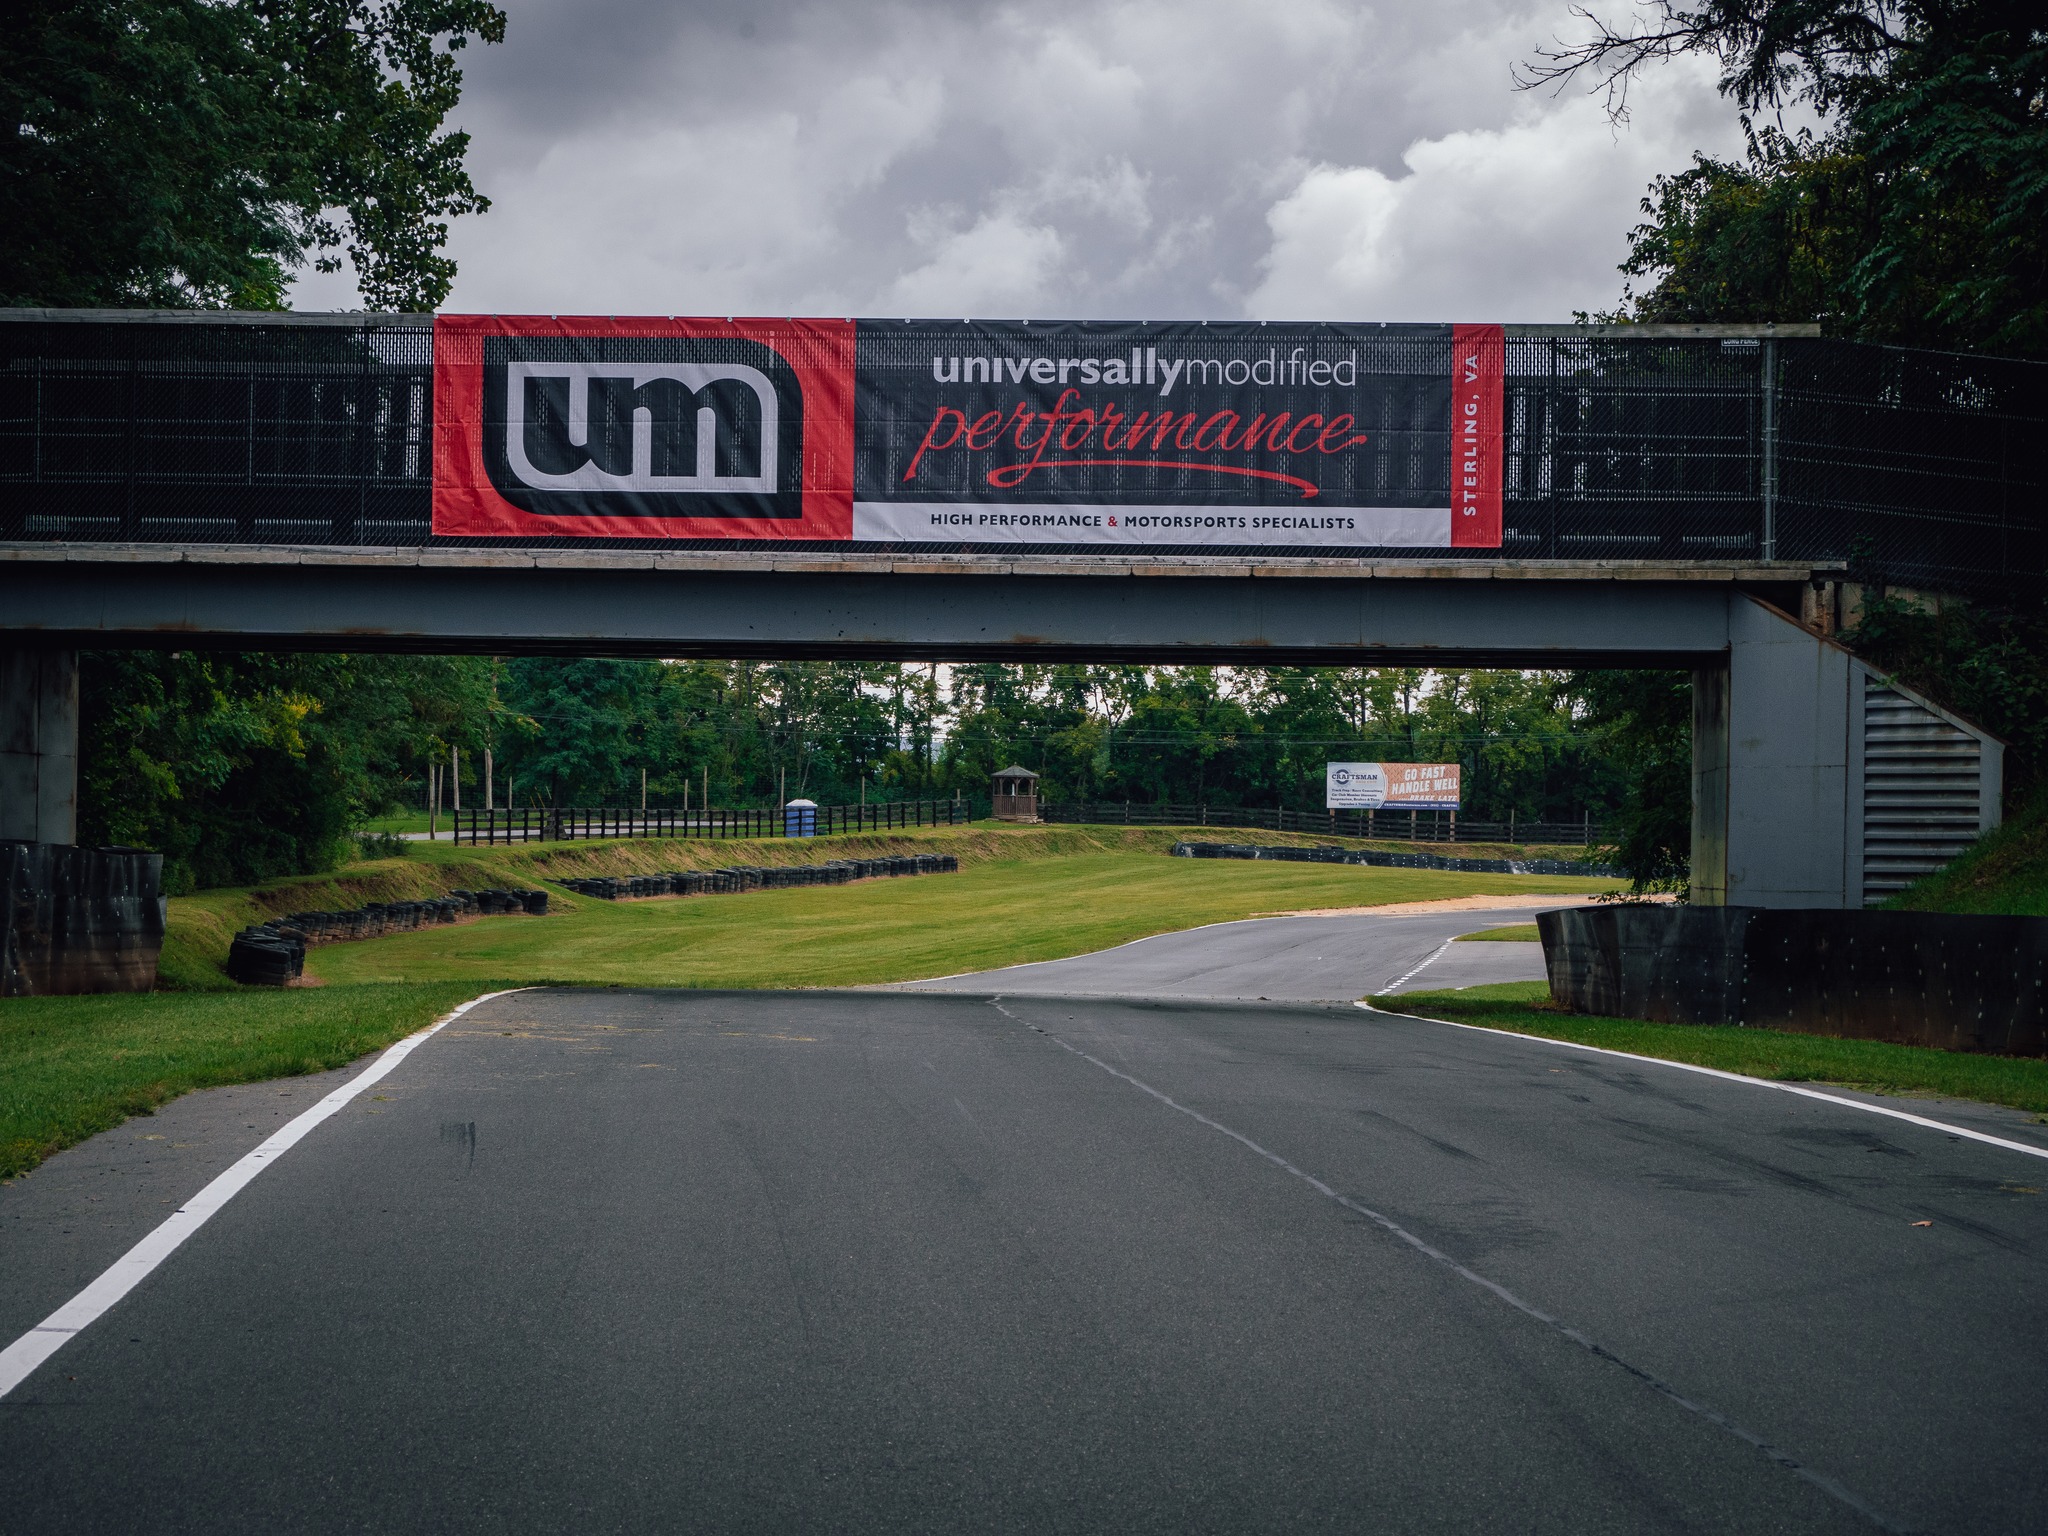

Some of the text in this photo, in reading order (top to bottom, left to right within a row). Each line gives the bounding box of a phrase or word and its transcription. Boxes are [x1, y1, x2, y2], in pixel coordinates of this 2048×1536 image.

[904, 388, 1368, 498] performance
[1463, 355, 1480, 516] STERLING, VA
[930, 513, 1356, 530] HIGH PERFORMANCE & MOTORSPORTS SPECIALISTS
[1405, 766, 1446, 781] GO FAST
[1392, 777, 1458, 795] HANDLE WELL
